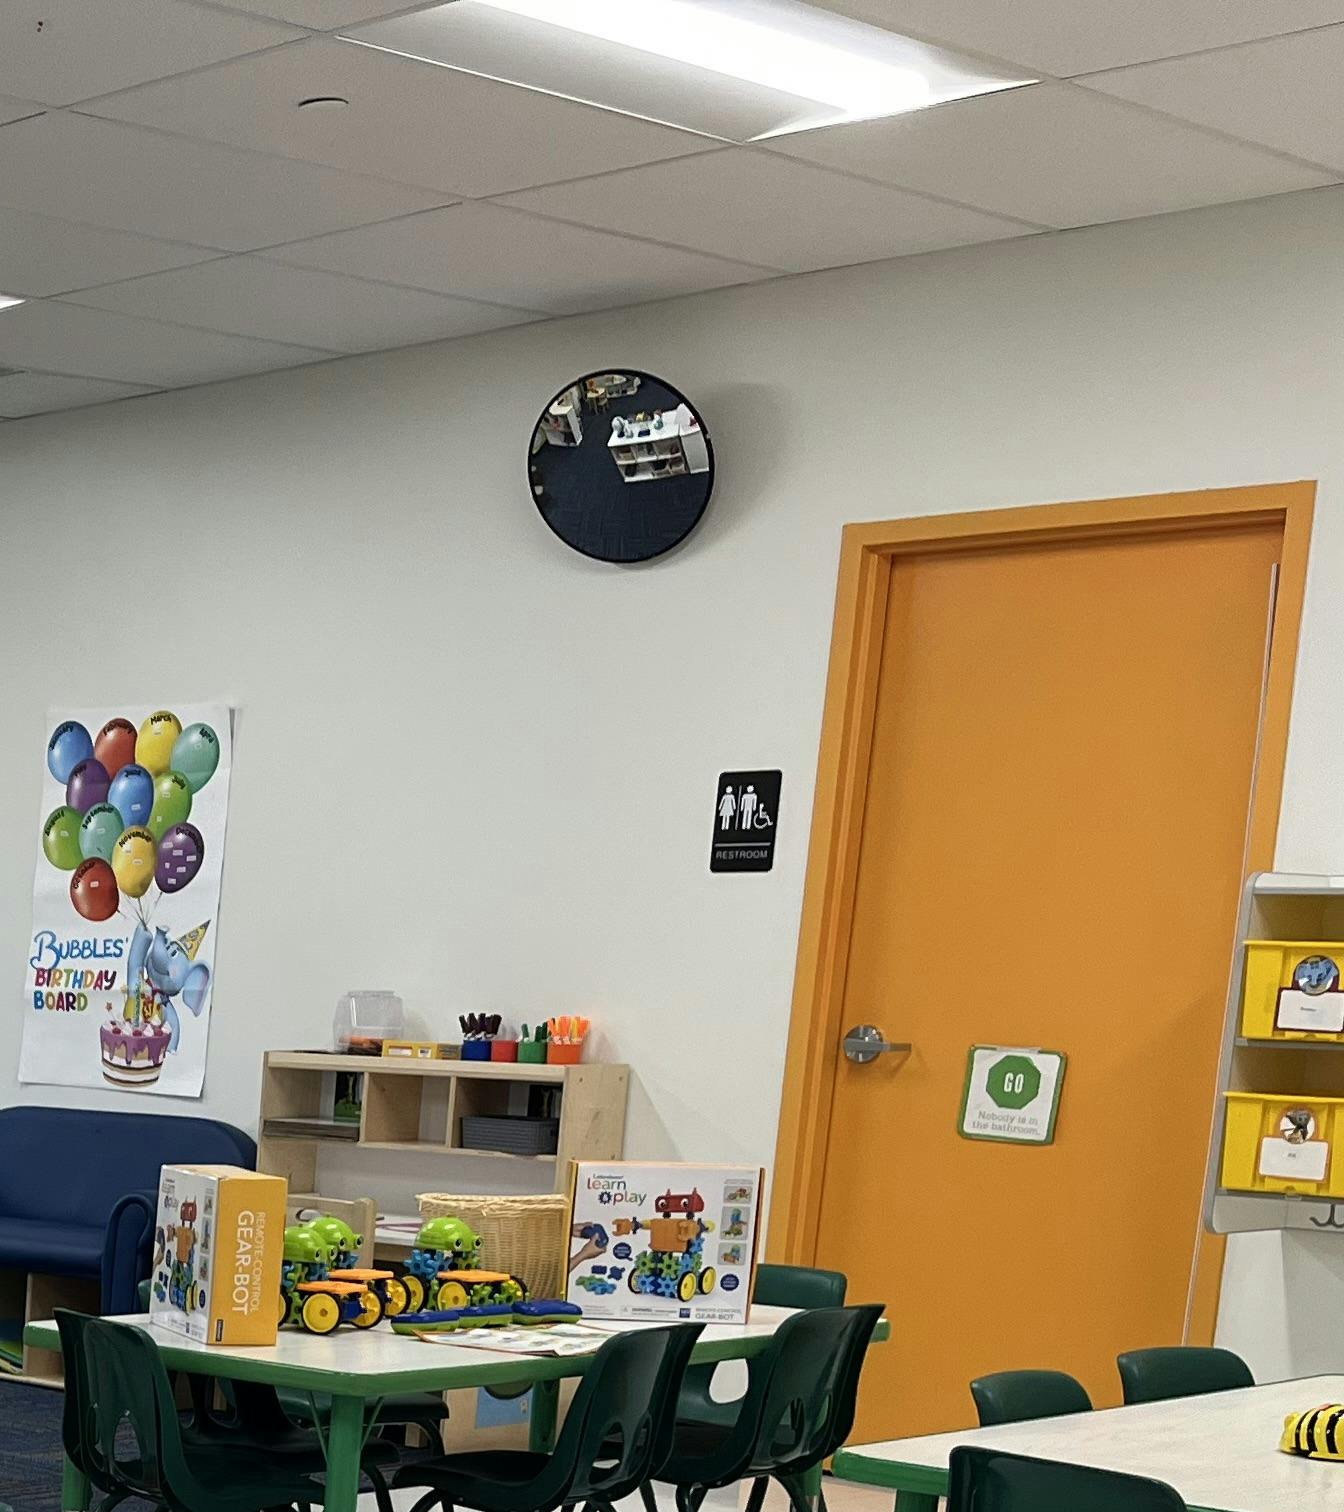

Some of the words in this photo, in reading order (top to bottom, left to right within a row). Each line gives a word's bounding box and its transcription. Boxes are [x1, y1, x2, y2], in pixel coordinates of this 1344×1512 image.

[715, 850, 768, 860] RESTROOM
[35, 967, 117, 991] BIRTHDAY
[33, 990, 88, 1012] BOARD
[1003, 1072, 1024, 1094] GO
[978, 1110, 1015, 1124] Nobody
[972, 1121, 989, 1130] the
[587, 1177, 626, 1190] learn
[613, 1191, 647, 1206] play
[232, 1210, 254, 1316] GEAR-BOT
